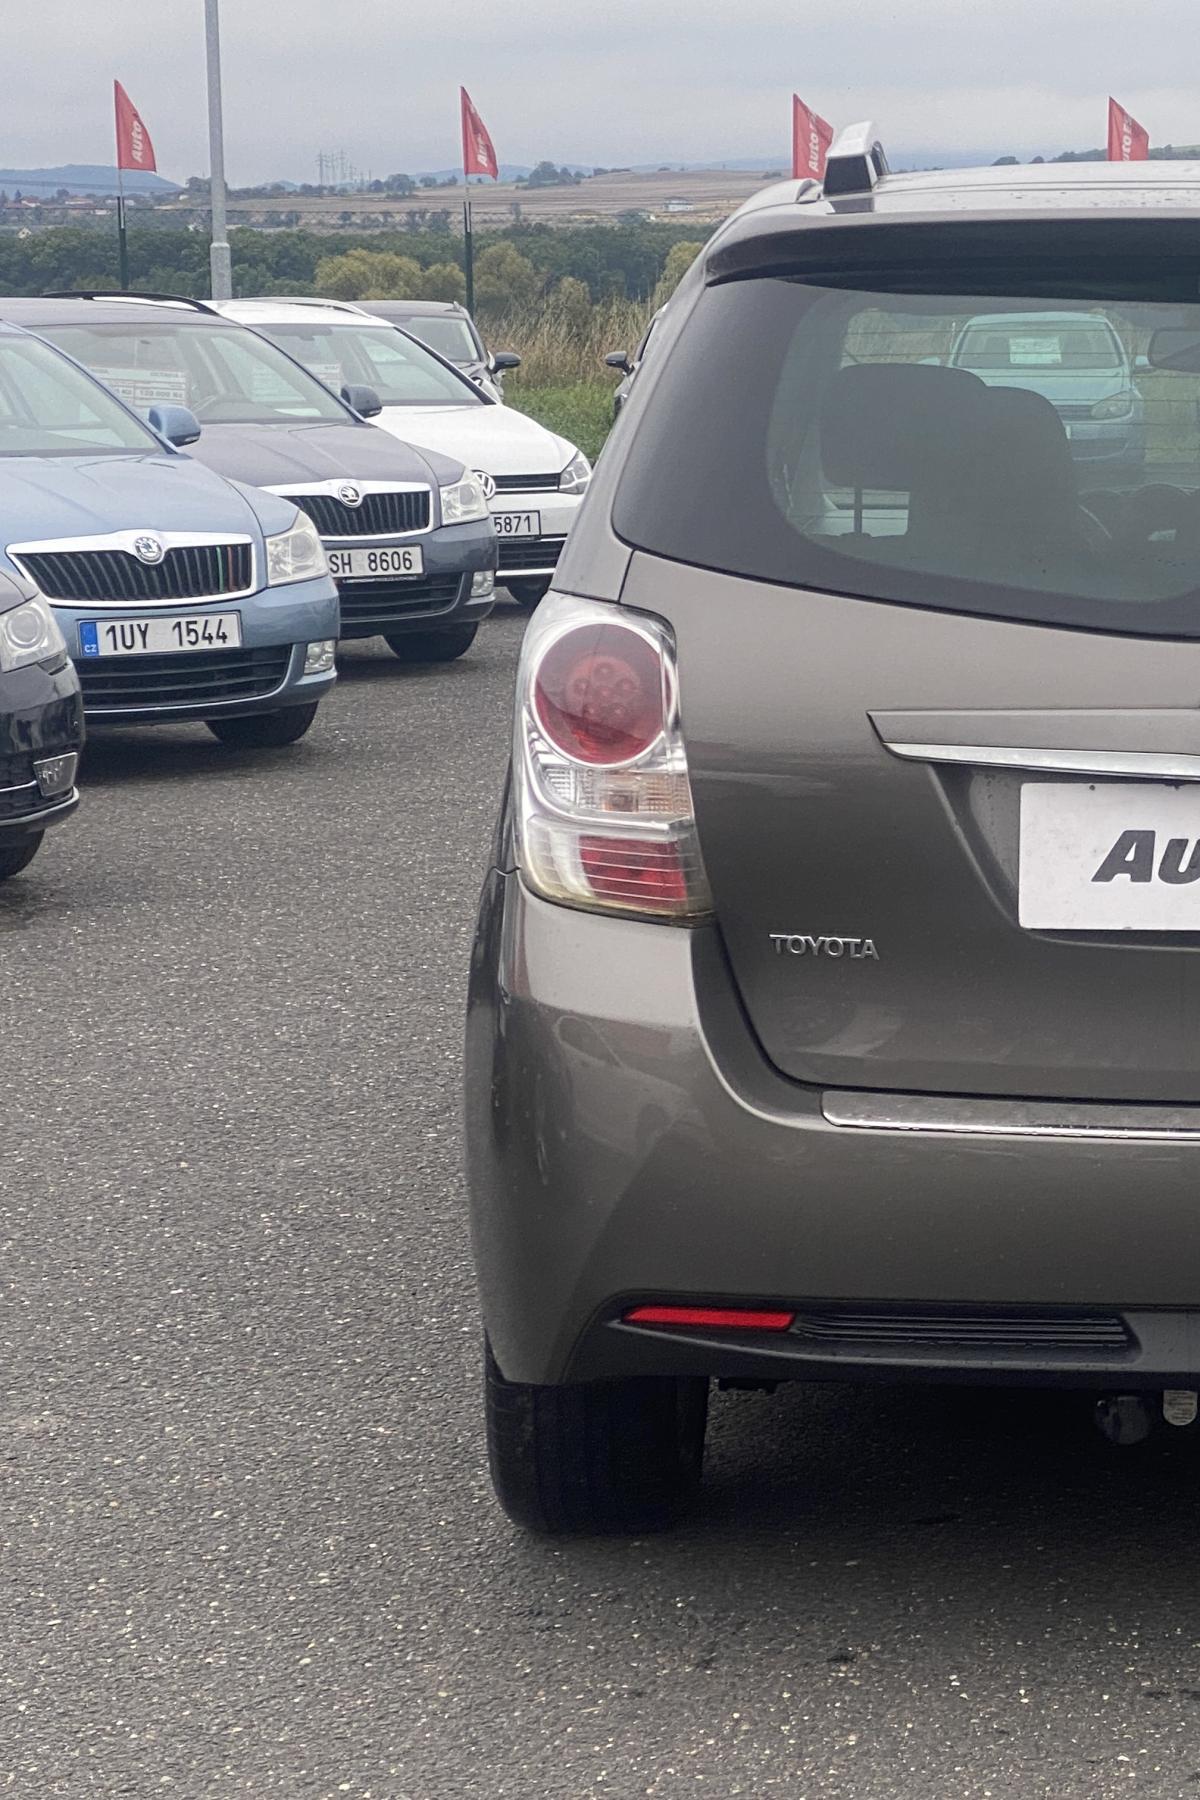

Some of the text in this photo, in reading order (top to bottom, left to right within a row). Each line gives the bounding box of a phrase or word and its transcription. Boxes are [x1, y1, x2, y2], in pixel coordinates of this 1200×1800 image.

[808, 132, 819, 173] Auto
[493, 514, 531, 533] 5871
[367, 550, 413, 572] 8606
[106, 618, 228, 651] 1UY 1544
[84, 643, 98, 653] CZ
[768, 933, 880, 961] TOYOTA
